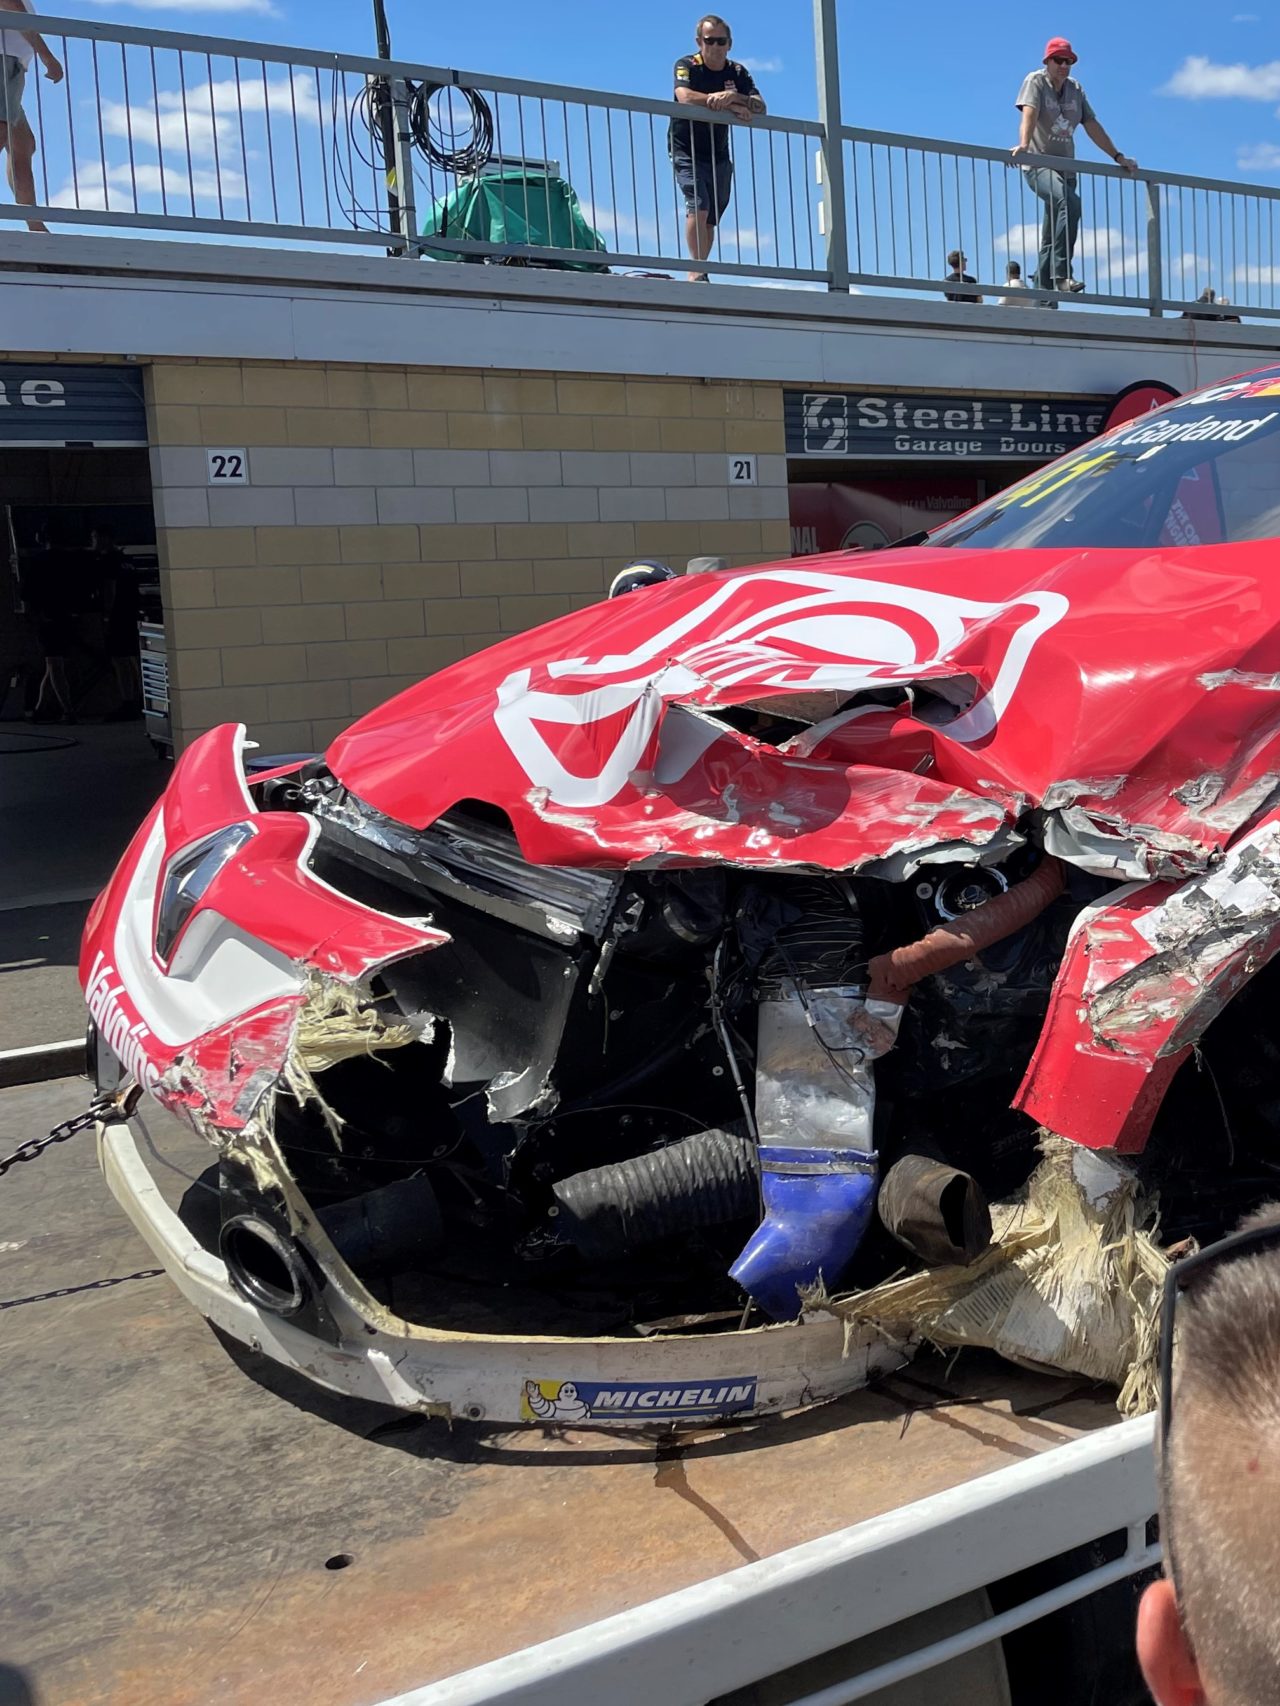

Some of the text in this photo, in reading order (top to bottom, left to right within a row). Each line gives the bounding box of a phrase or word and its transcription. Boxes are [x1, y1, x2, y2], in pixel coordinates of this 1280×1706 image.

[894, 435, 1066, 456] Garage Doors
[211, 455, 243, 478] 22
[733, 460, 752, 480] 21
[593, 1384, 753, 1408] MICHELIN
